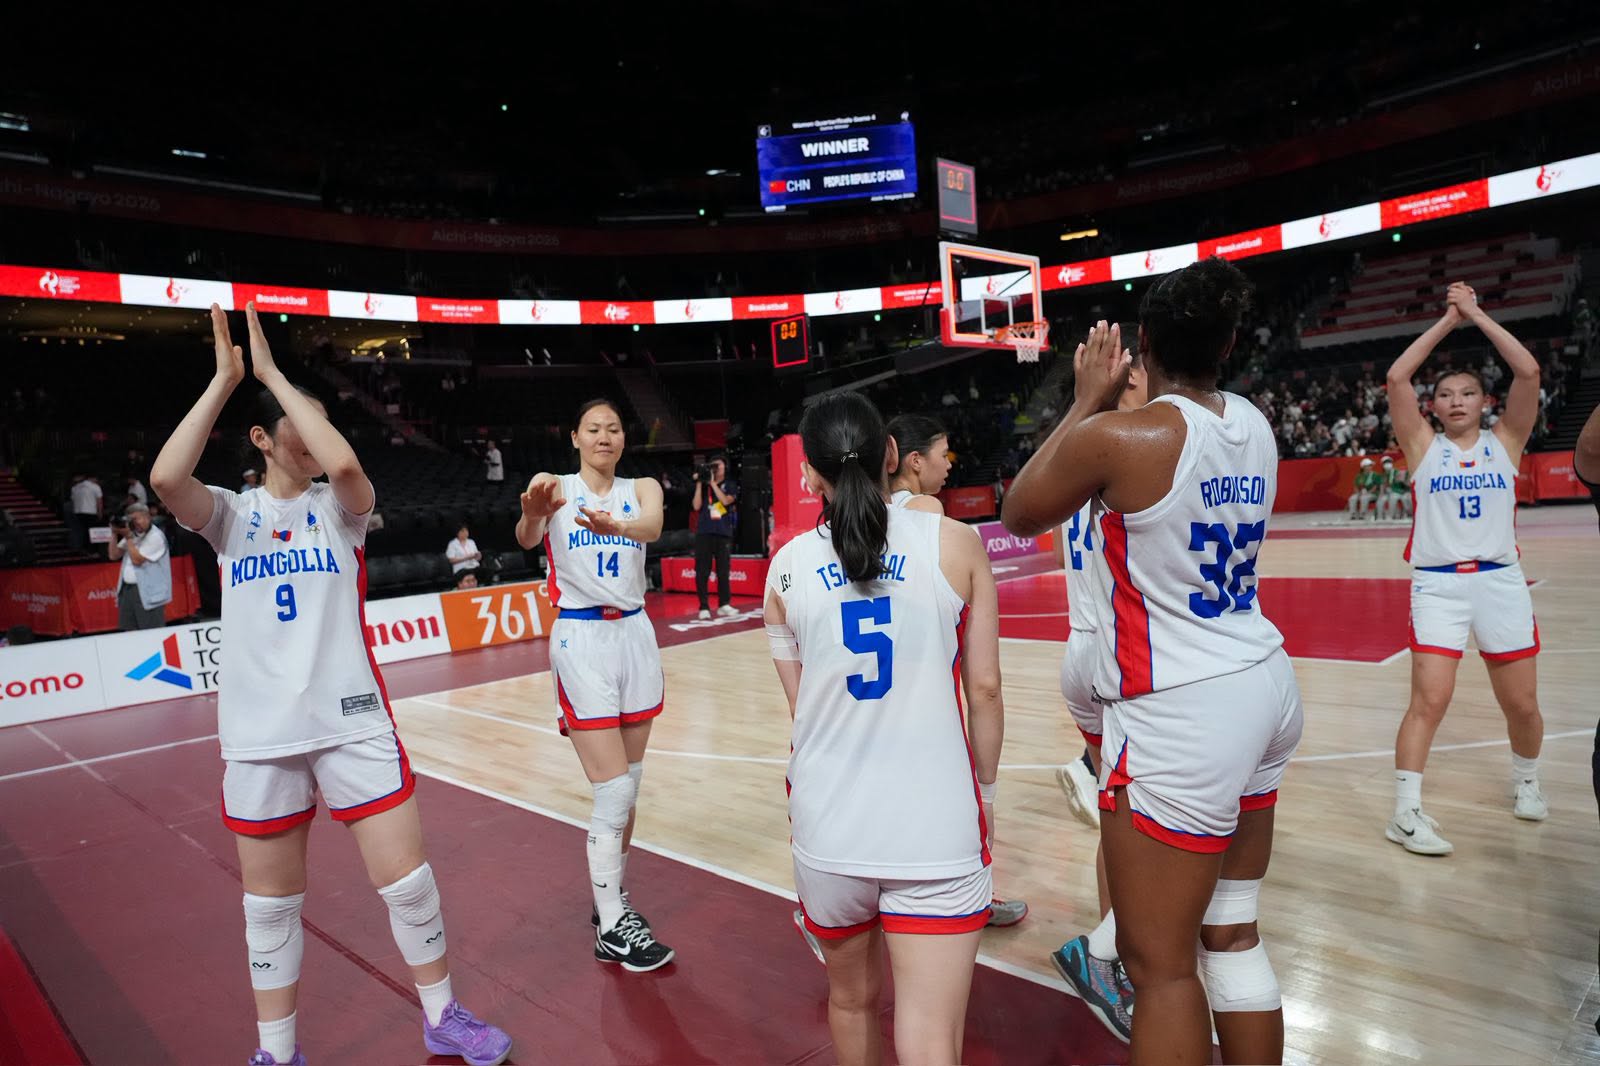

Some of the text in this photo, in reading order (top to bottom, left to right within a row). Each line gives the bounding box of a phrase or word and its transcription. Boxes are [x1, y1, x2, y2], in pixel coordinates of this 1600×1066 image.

[801, 137, 869, 158] WINNER
[786, 179, 811, 192] CHN
[877, 170, 886, 182] OF
[886, 169, 905, 181] CHINA
[1216, 236, 1262, 255] Basketball
[256, 293, 308, 306] Basketball
[1430, 473, 1507, 494] MONGOLIA
[1459, 495, 1481, 519] 13
[231, 547, 340, 587] MONGOLIA
[597, 551, 619, 577] 14
[1188, 519, 1265, 618] 32
[275, 583, 297, 622] 9
[841, 596, 893, 701] 5
